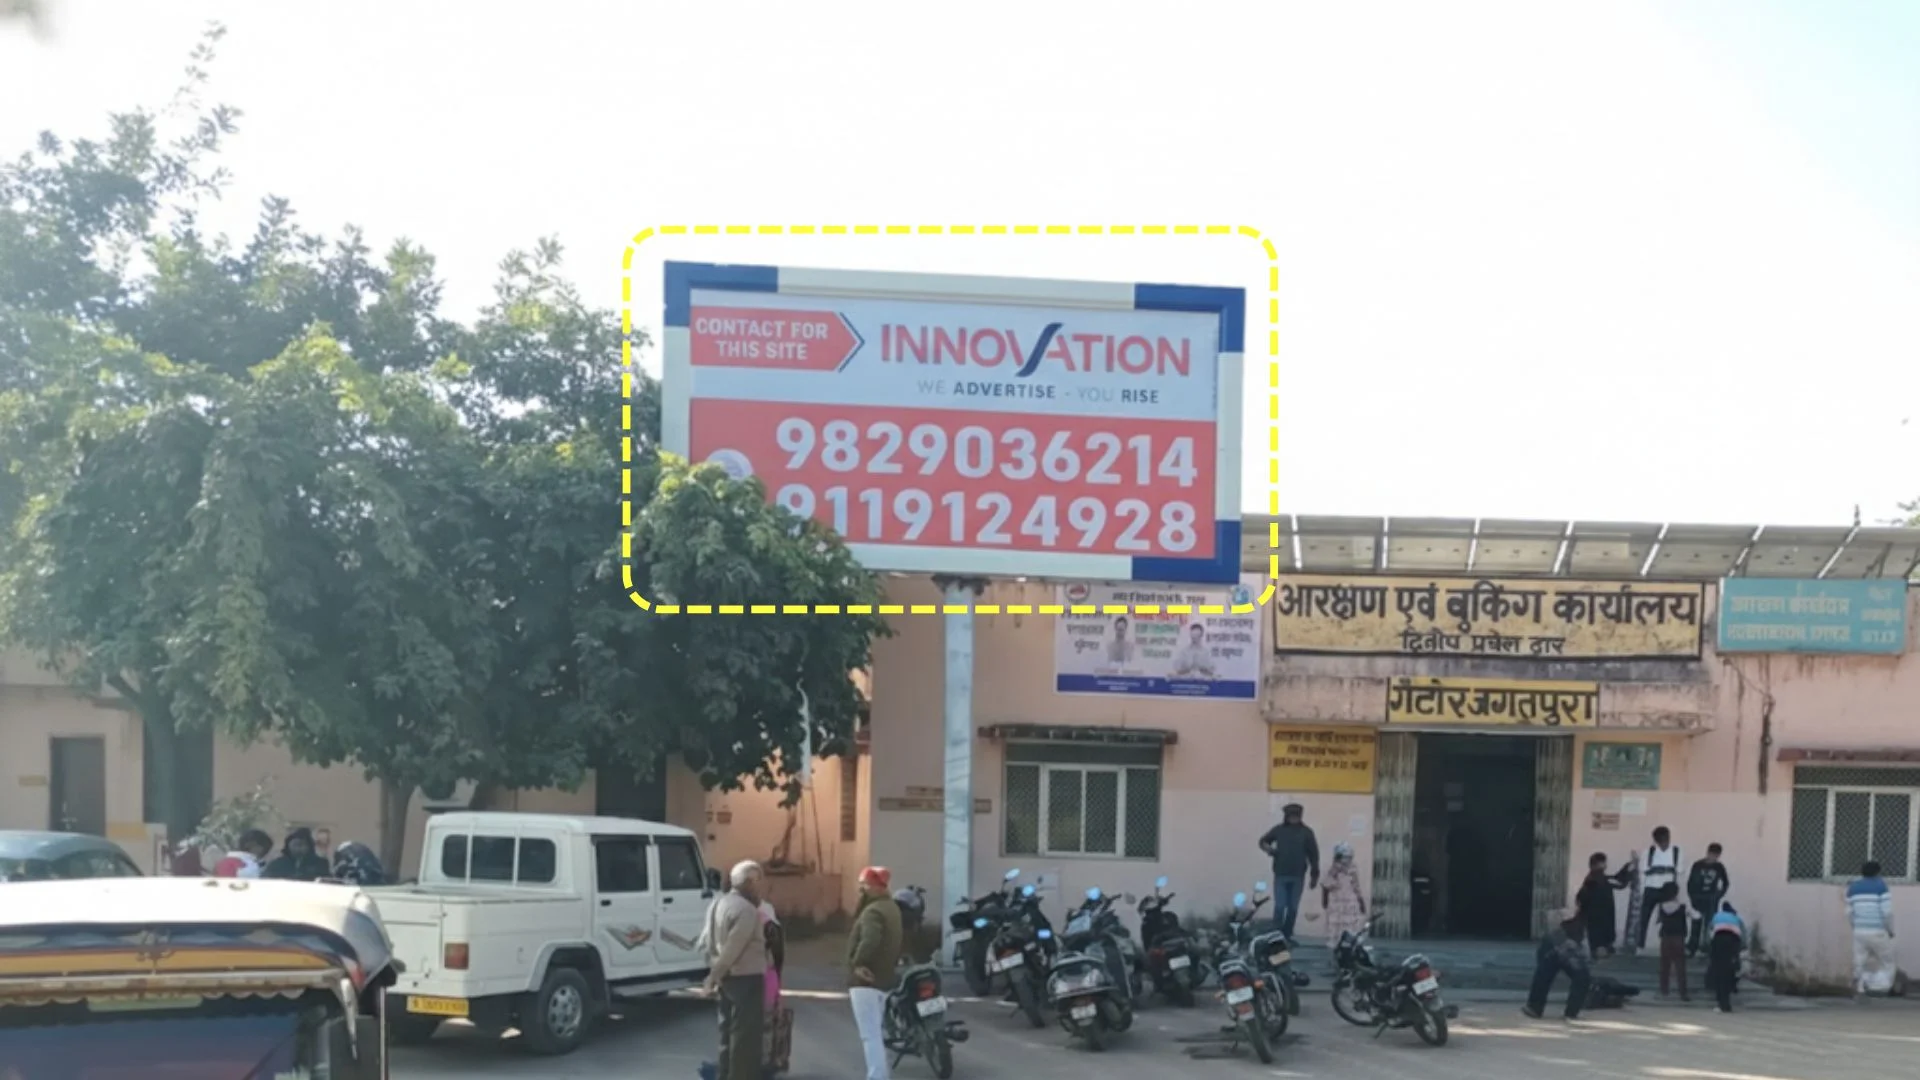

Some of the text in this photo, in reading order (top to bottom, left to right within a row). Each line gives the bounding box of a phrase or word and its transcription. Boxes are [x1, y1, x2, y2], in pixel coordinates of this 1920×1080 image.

[695, 317, 829, 339] CONTACT FOR
[716, 340, 808, 360] THIS SITE
[881, 323, 1191, 377] INNOVATION
[917, 380, 947, 395] WE
[953, 382, 1056, 399] ADVERTISE
[1077, 386, 1114, 402] YOU
[1121, 389, 1159, 404] RISE
[776, 417, 1198, 487] 9829036214
[776, 483, 1197, 553] 9119124928
[1279, 583, 1388, 619] आरक्षण
[1394, 582, 1439, 624] एवं
[1446, 579, 1547, 633] बुकिंग
[1553, 585, 1699, 625] कार्यालय
